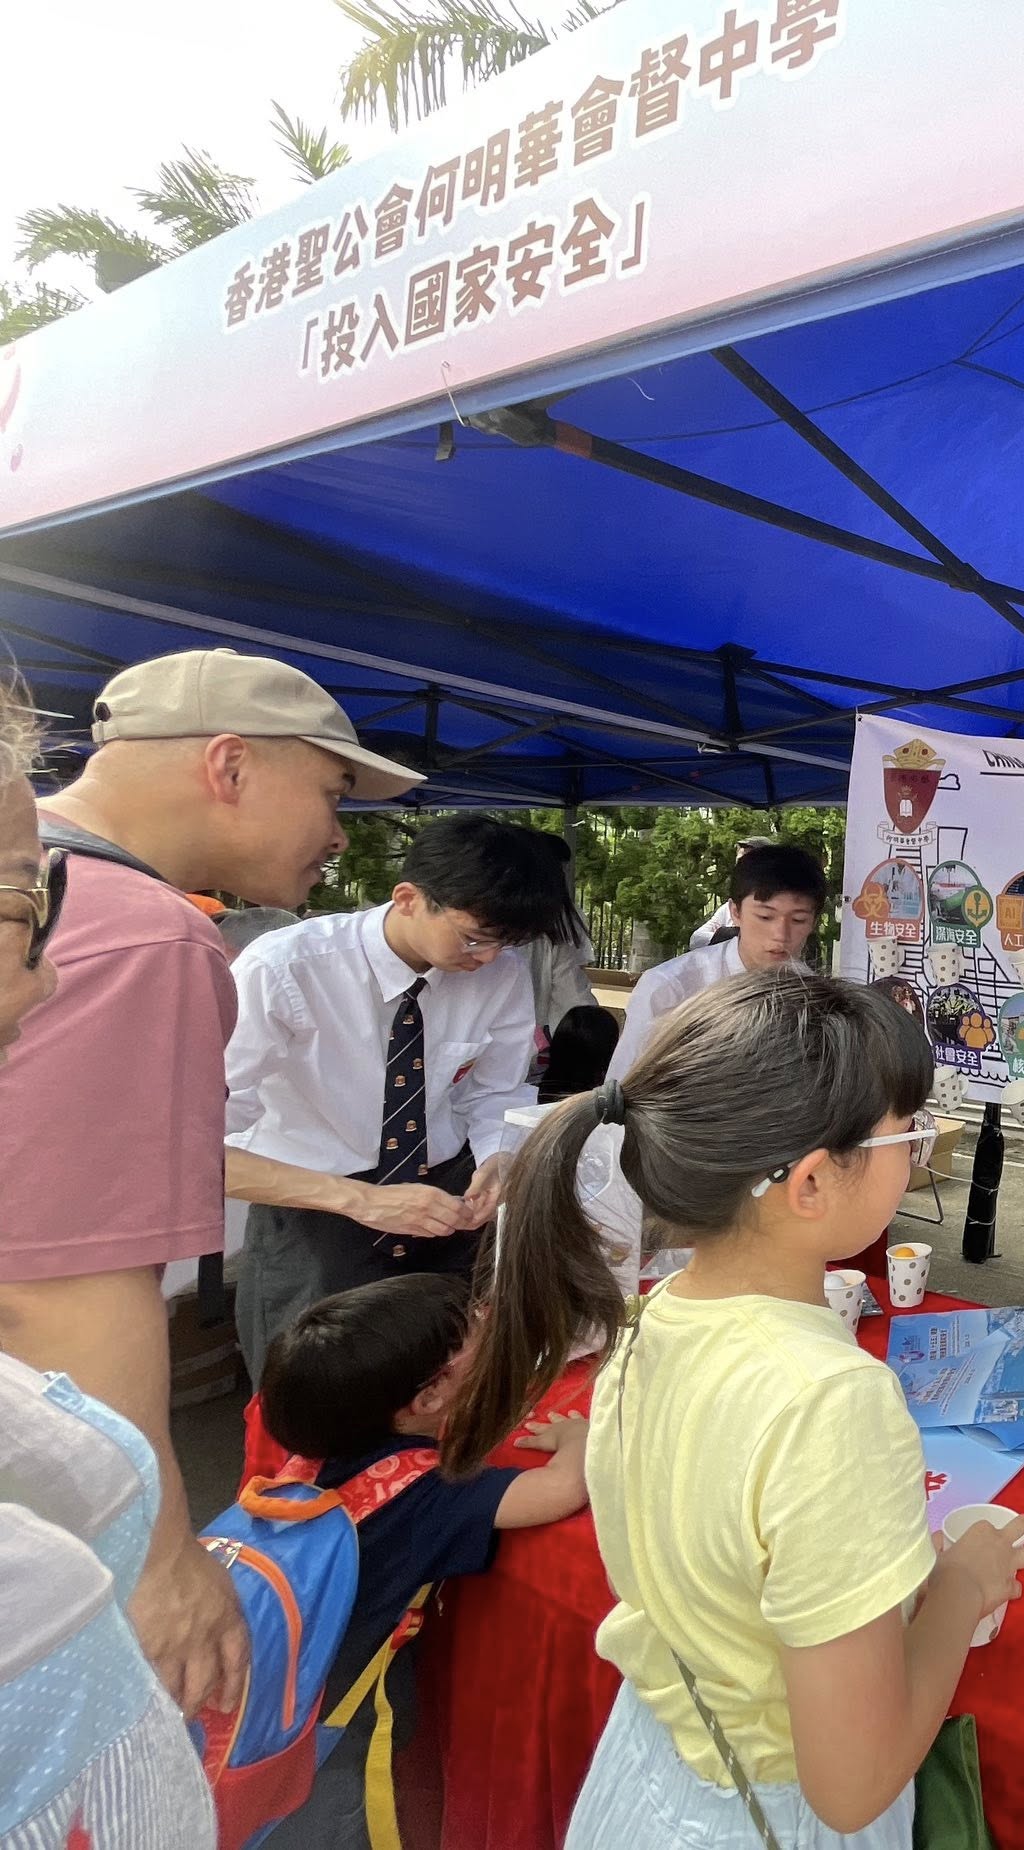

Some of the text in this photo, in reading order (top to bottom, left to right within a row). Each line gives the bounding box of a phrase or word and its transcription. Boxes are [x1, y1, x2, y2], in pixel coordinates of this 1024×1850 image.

[225, 0, 840, 327] 香港聖公會何明華會督中學
[300, 197, 648, 377] 「投入國家安全」
[870, 921, 917, 938] 生物安全
[935, 924, 977, 946] 深海安全
[935, 1044, 979, 1067] 社會安全
